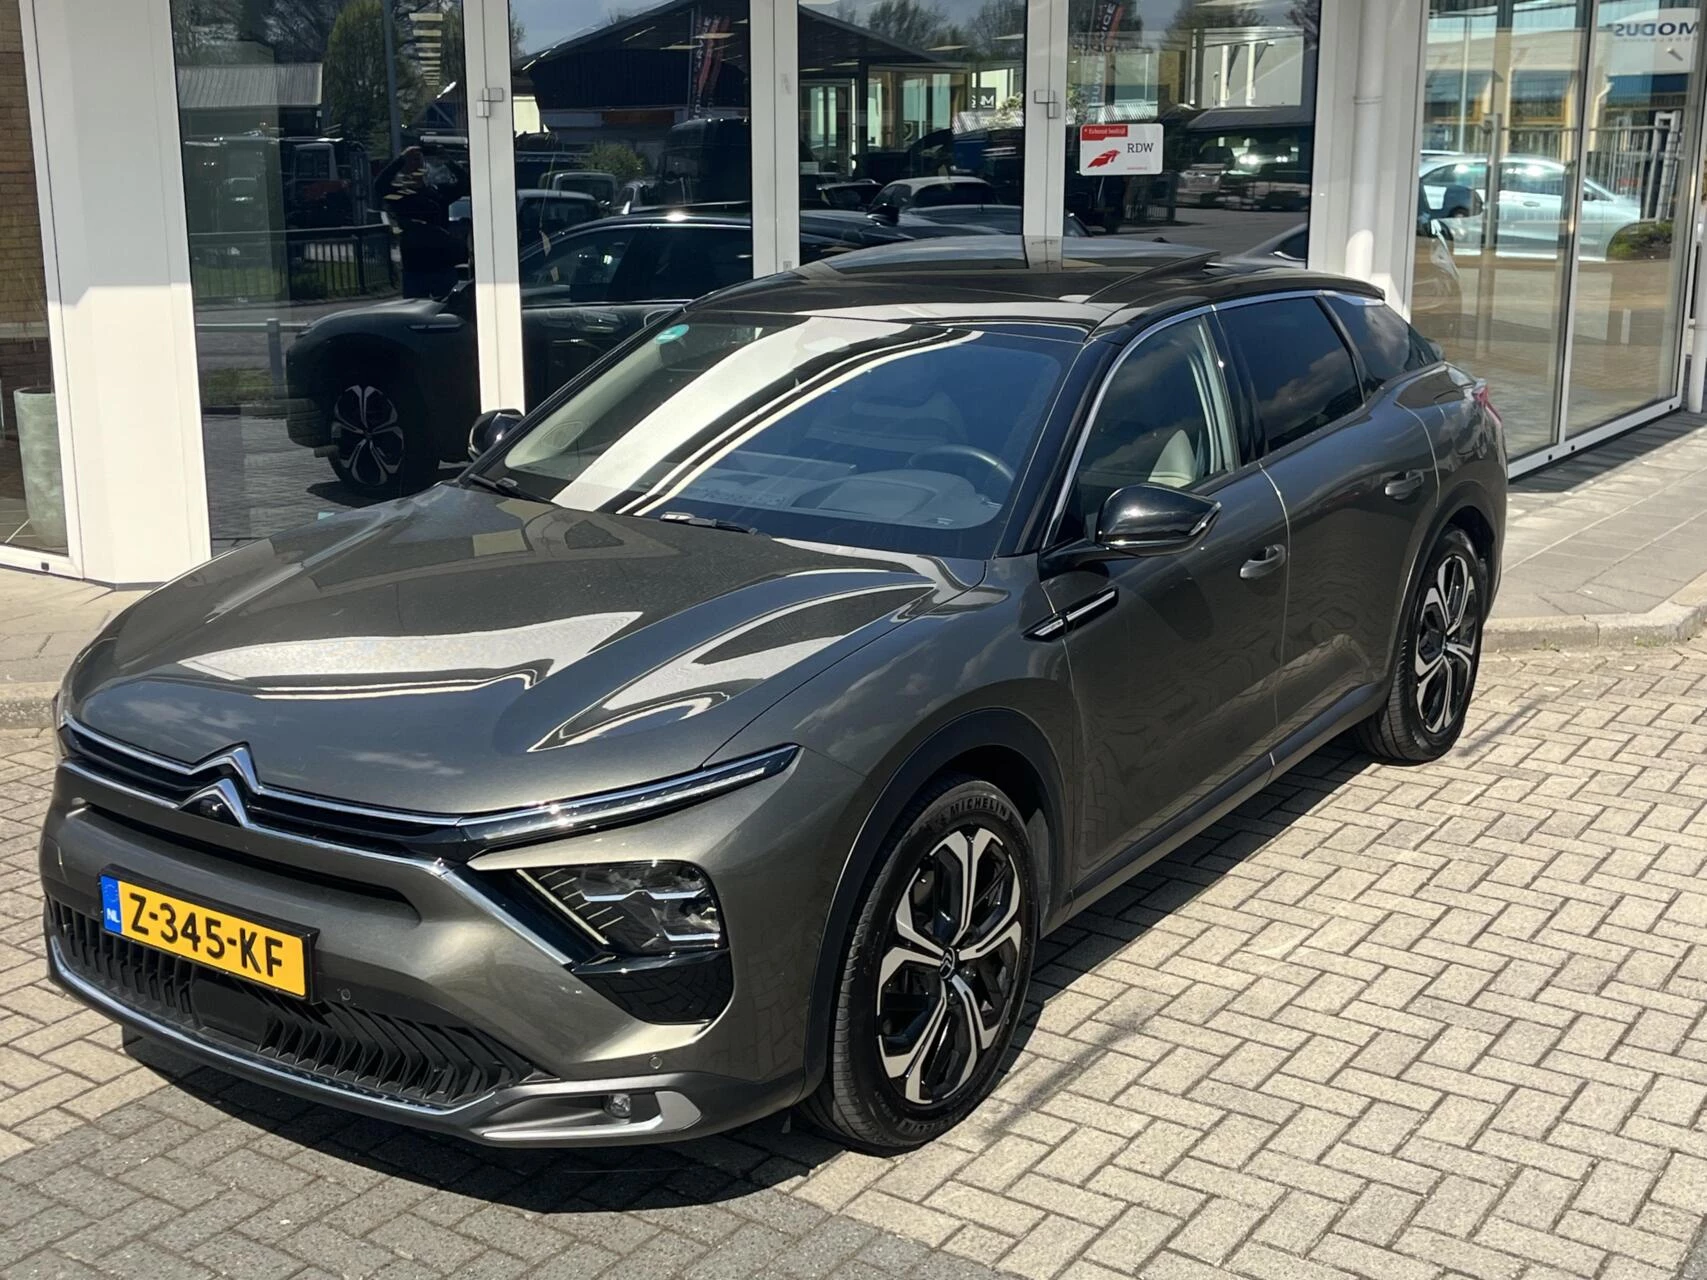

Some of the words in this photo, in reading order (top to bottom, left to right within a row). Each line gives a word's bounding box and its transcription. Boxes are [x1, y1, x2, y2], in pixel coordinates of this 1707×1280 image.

[1127, 142, 1154, 154] RDW
[948, 797, 1010, 821] MICHELIN
[106, 907, 121, 924] NL
[129, 892, 283, 977] Z-345-KF
